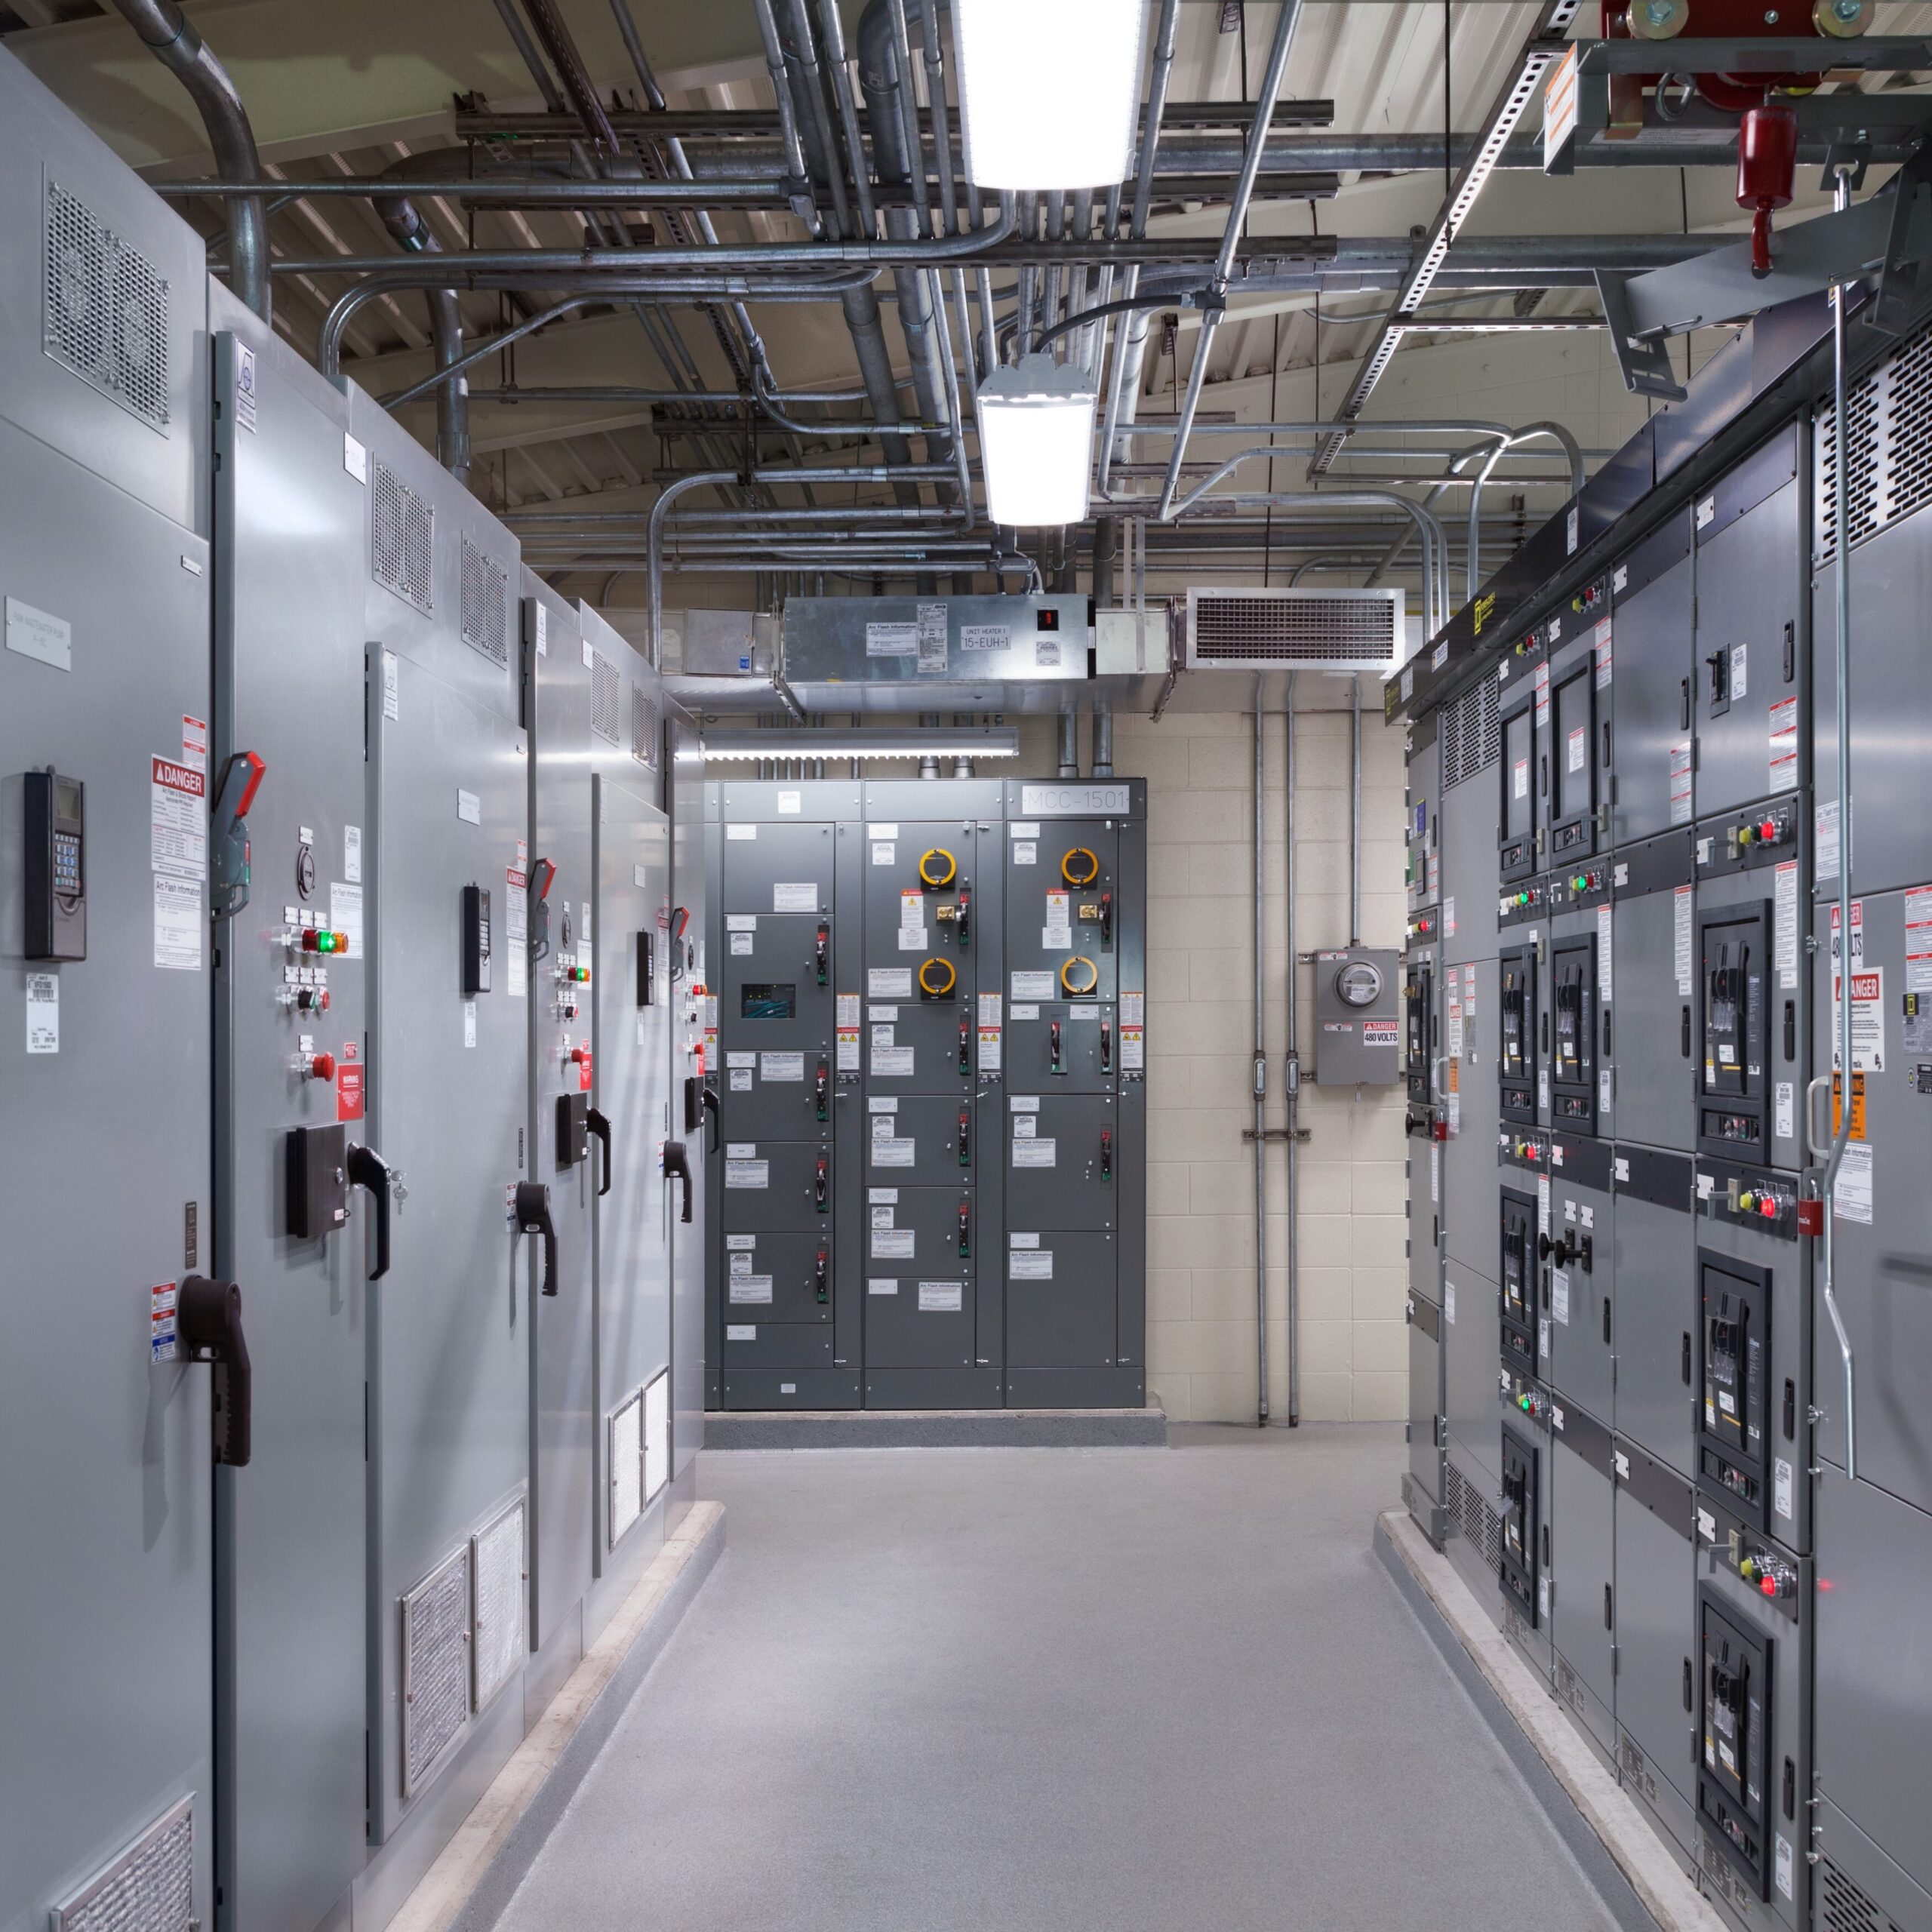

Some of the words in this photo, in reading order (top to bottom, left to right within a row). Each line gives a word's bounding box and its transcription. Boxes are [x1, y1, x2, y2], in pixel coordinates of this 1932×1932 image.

[964, 637, 1008, 648] 15-EUH-1
[165, 765, 202, 792] DANGER
[1028, 792, 1124, 808] MCC-1501
[165, 881, 177, 893] Flash
[178, 884, 200, 896] Information
[1851, 979, 1877, 998] ANGER
[1365, 1033, 1377, 1041] 480
[1377, 1033, 1397, 1041] VOLTS
